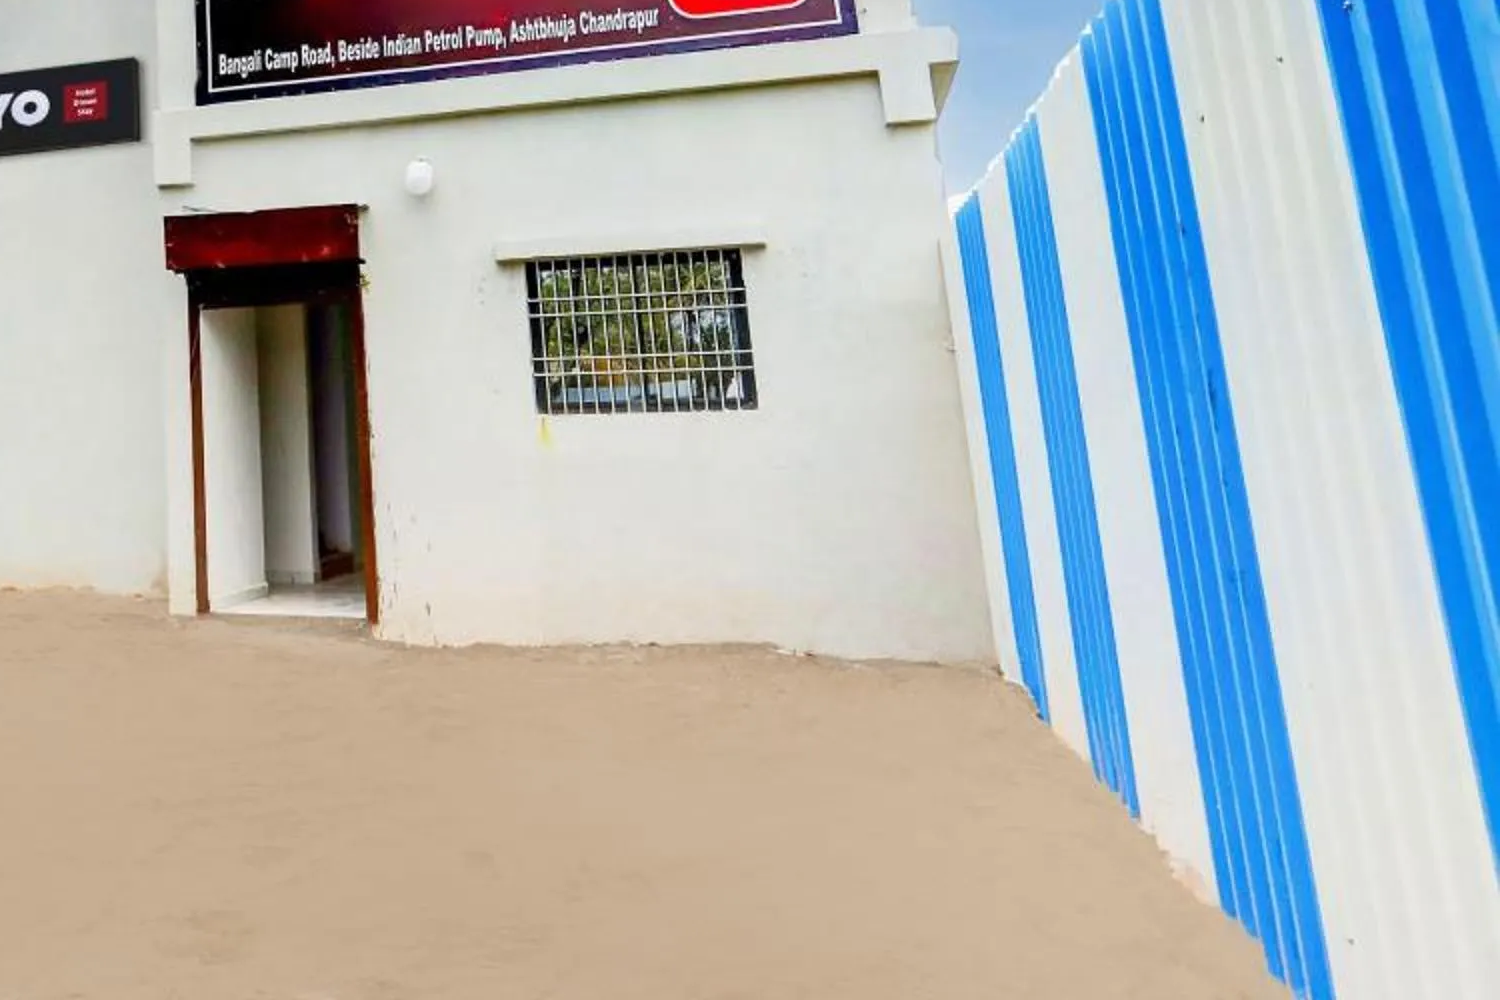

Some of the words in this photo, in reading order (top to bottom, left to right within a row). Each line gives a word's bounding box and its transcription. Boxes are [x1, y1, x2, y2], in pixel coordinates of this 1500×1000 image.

[219, 49, 262, 79] Bangali
[264, 47, 299, 73] Camp
[301, 42, 336, 68] Road,
[337, 37, 380, 61] Beside
[384, 34, 422, 56] Indian
[424, 28, 463, 53] Petrol
[465, 24, 508, 50] Pump,
[509, 17, 577, 43] Ashtbhuja
[578, 7, 660, 35] Chandrapur
